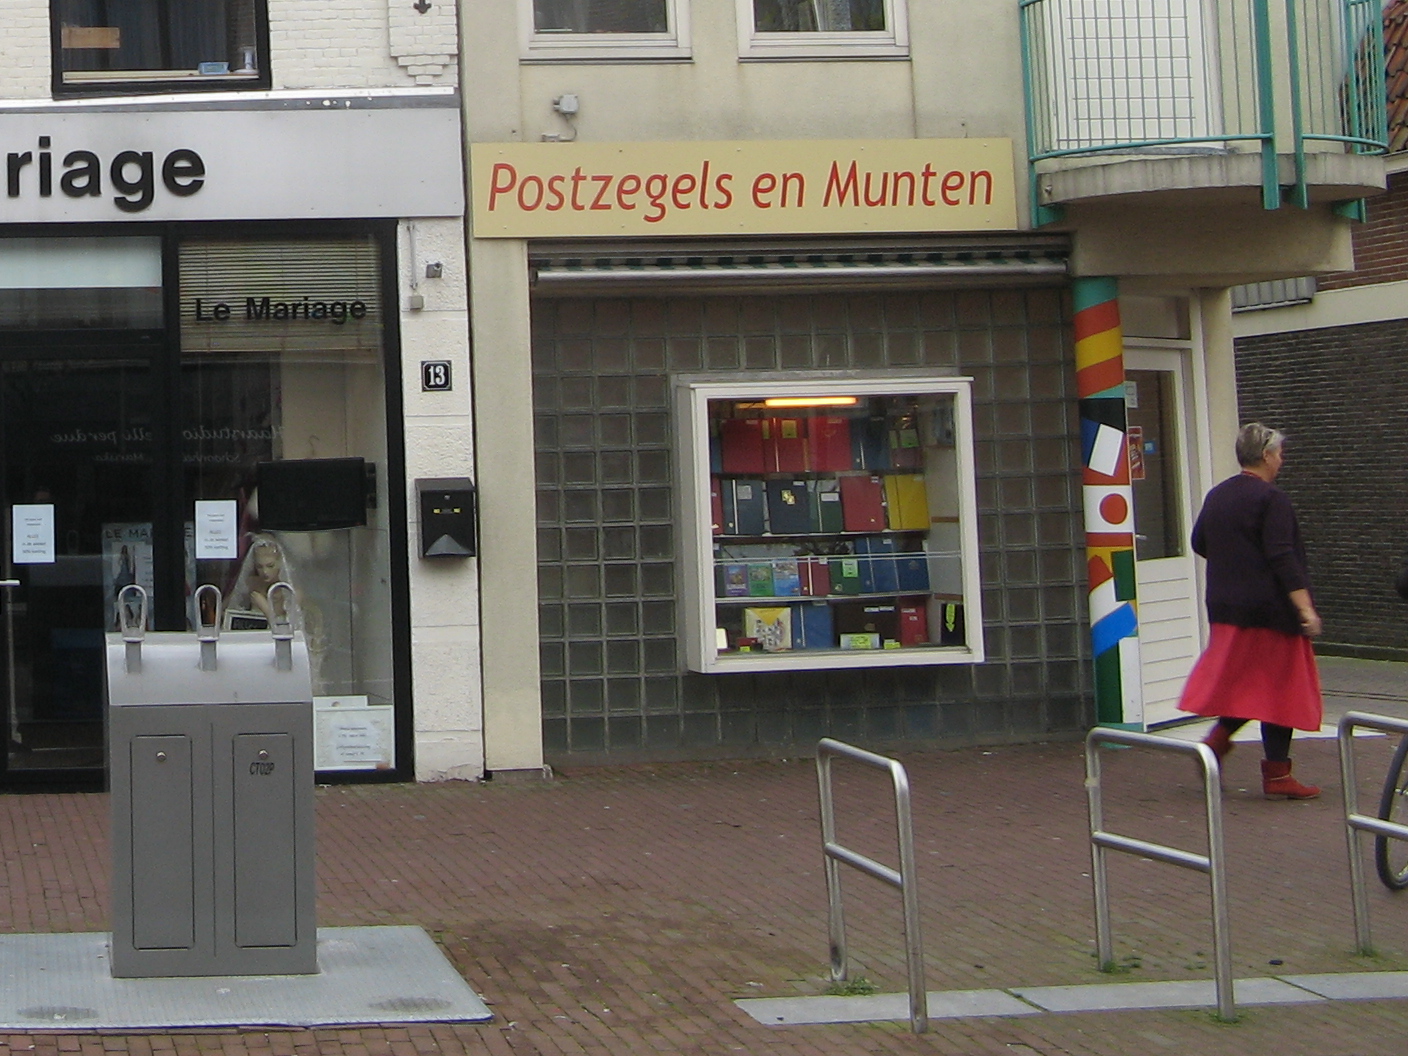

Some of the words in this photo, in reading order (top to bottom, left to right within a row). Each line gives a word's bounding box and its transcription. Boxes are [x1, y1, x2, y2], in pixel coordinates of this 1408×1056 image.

[488, 160, 733, 223] Postzegels
[752, 170, 805, 208] en
[823, 160, 993, 207] Munten
[195, 298, 231, 322] Le
[246, 297, 368, 325] Mariage
[428, 365, 446, 386] 13
